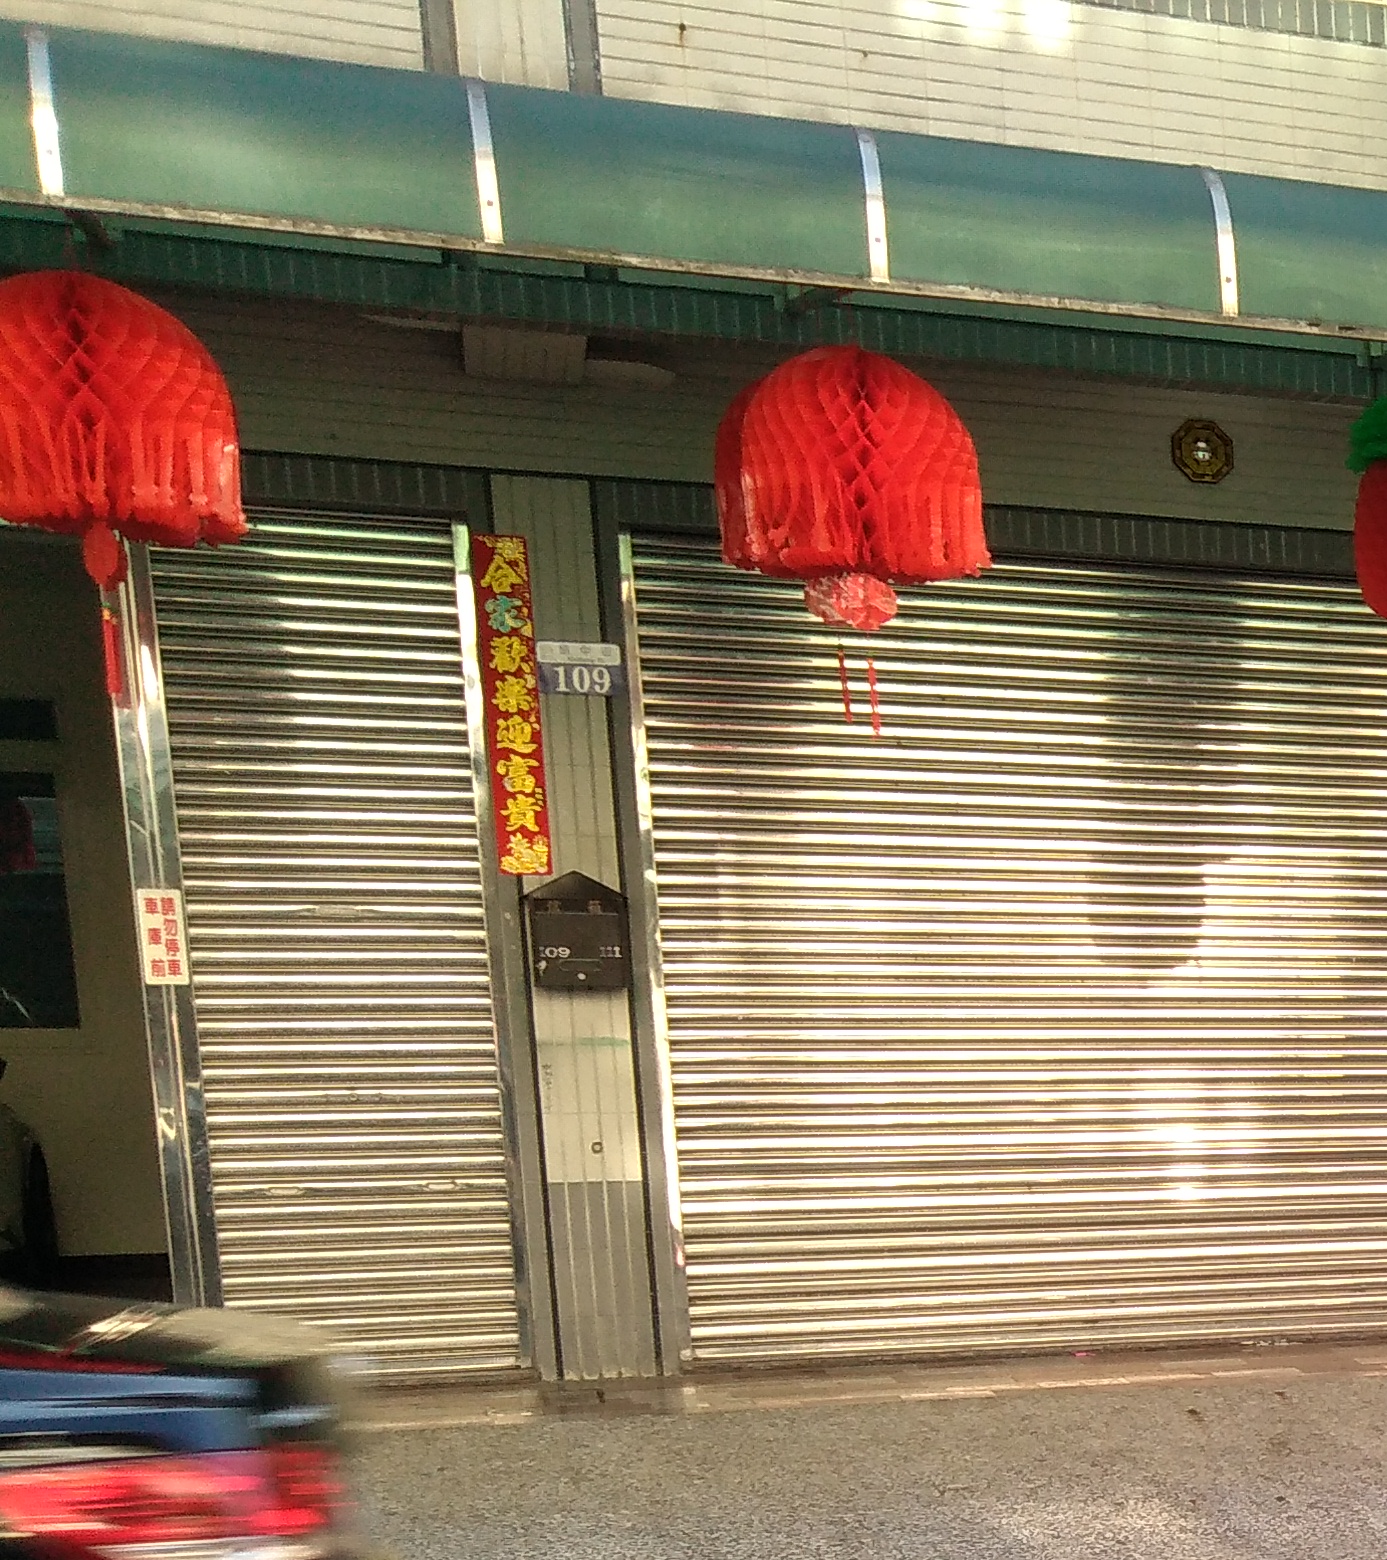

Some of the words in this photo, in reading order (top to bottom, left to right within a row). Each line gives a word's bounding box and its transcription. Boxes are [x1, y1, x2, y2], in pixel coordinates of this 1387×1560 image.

[554, 666, 611, 693] 109
[144, 897, 166, 977] 車庫前
[160, 897, 183, 976] 請勿停車
